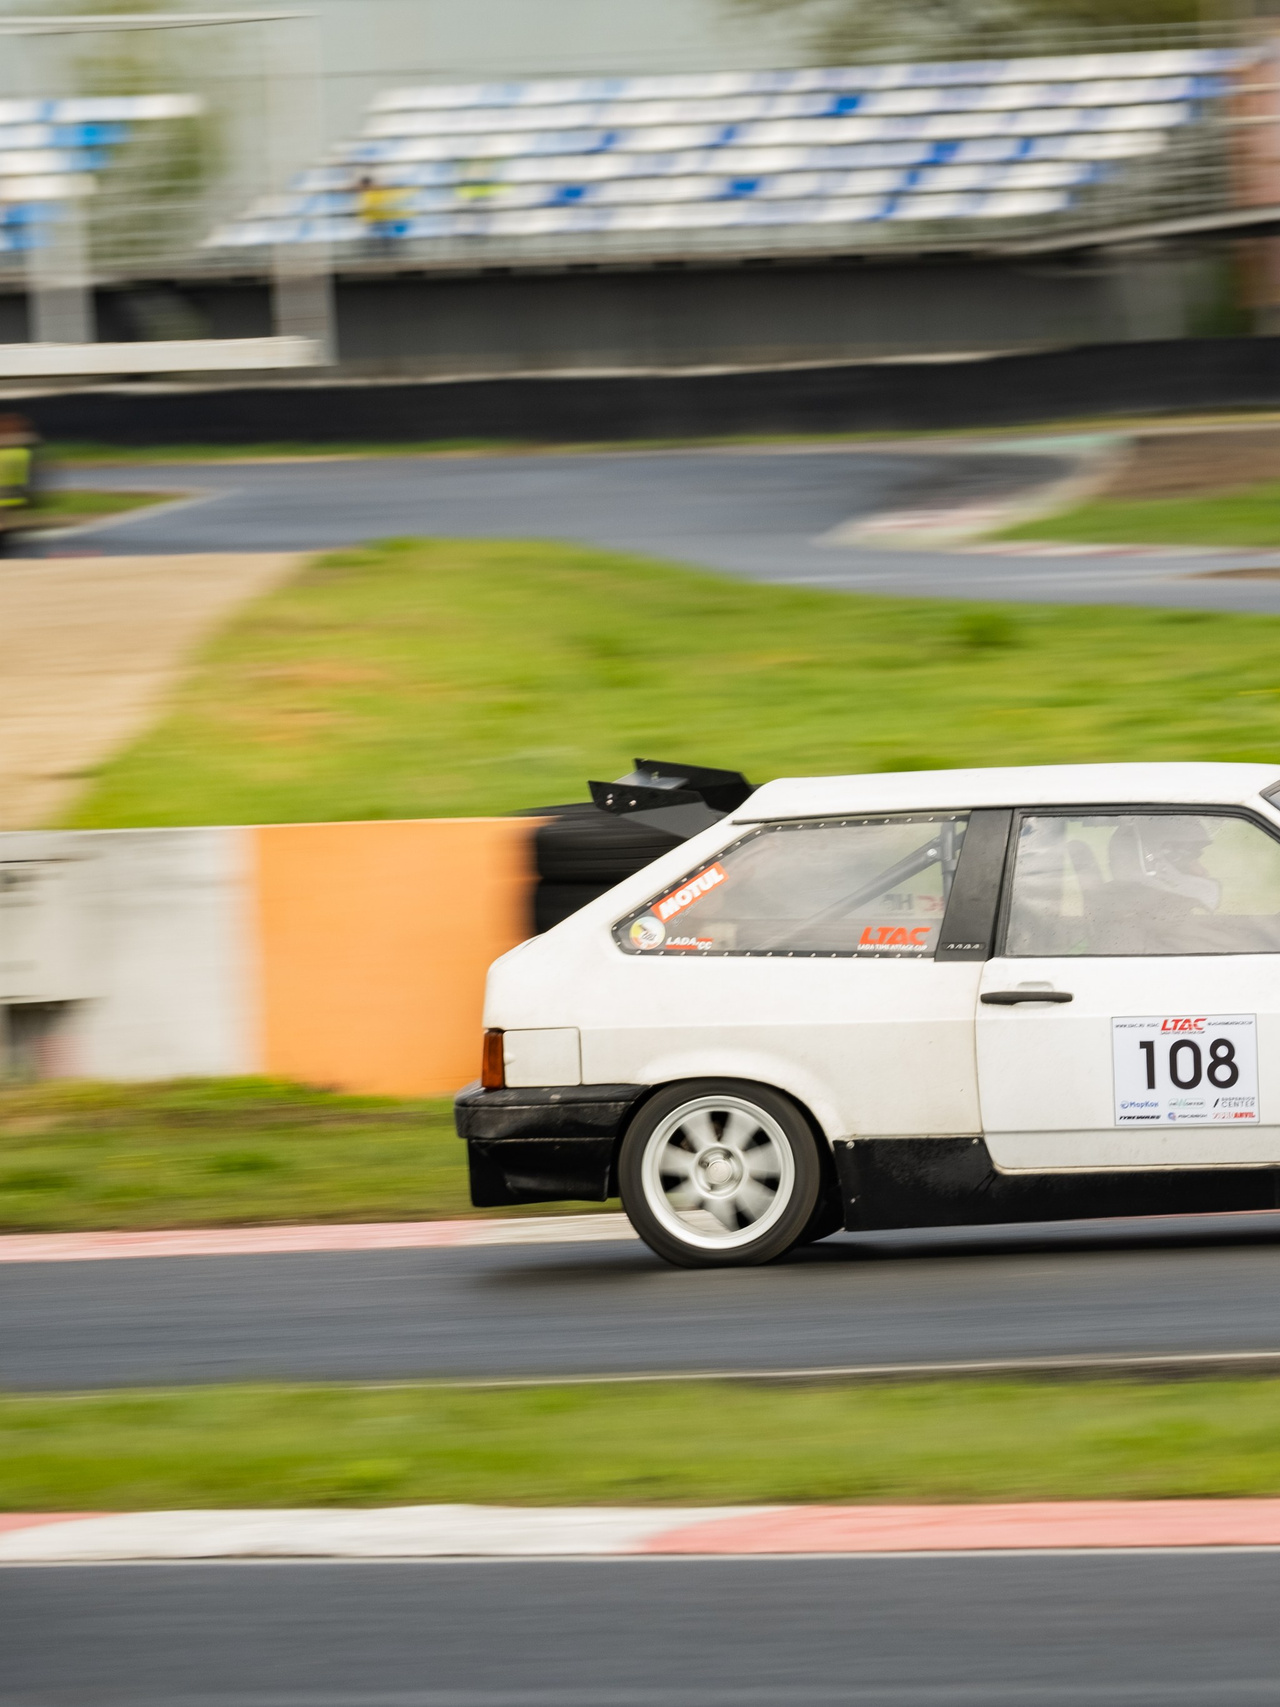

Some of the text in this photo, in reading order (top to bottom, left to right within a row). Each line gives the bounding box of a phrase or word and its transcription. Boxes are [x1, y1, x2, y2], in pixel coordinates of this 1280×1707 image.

[658, 868, 725, 920] MOTUL
[858, 926, 932, 945] LTAC
[1160, 1018, 1208, 1031] LTAC
[1139, 1038, 1239, 1090] 108
[1221, 1100, 1255, 1108] CENTER
